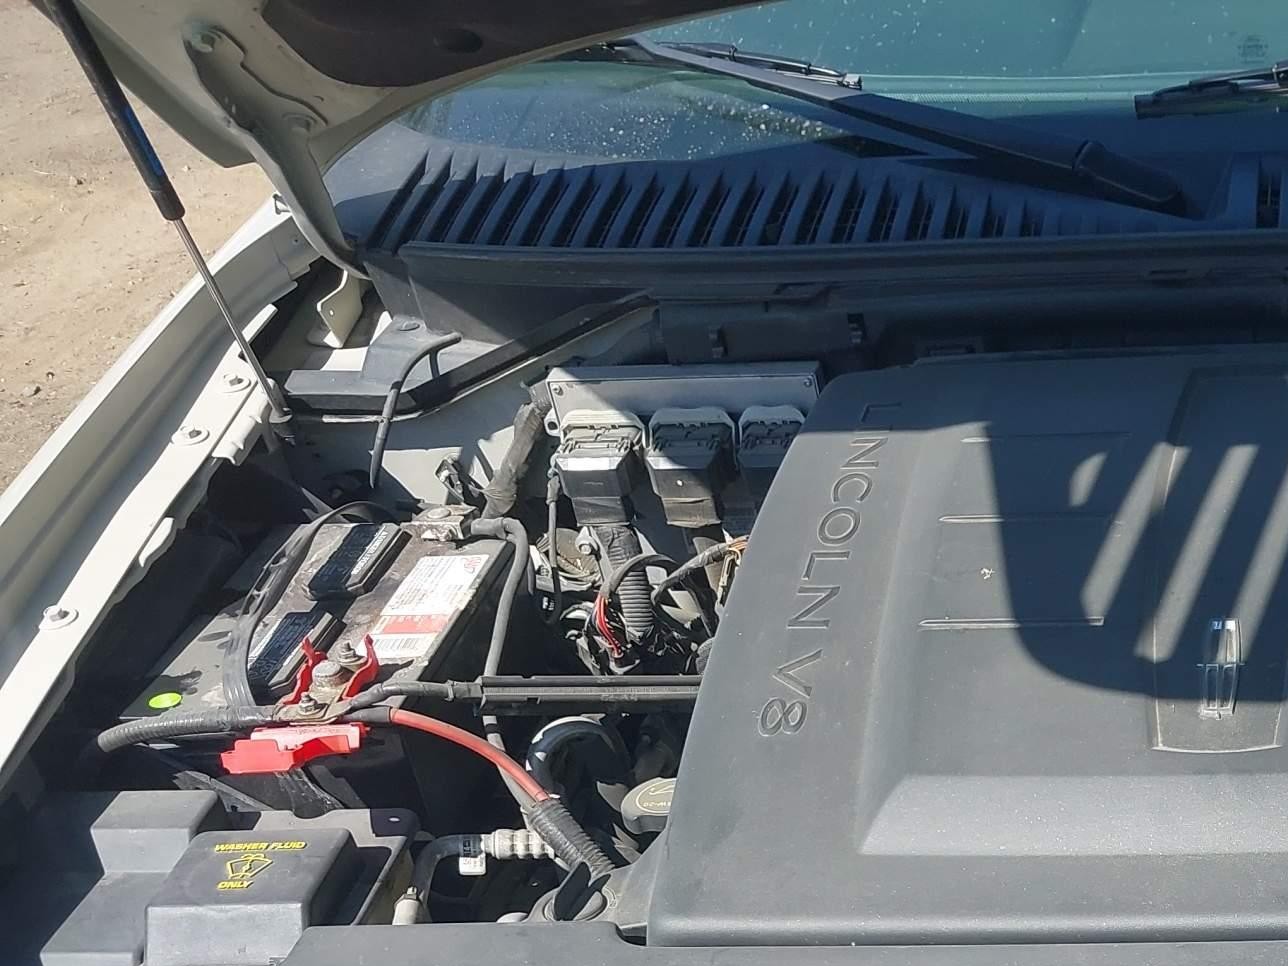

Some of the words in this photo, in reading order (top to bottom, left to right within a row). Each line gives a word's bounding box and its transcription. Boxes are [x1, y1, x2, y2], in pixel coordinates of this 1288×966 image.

[786, 401, 904, 629] LINCOLN
[758, 648, 823, 737] V8
[214, 842, 268, 853] WASHER
[269, 841, 307, 851] FLUID
[216, 880, 254, 890] ONLY
